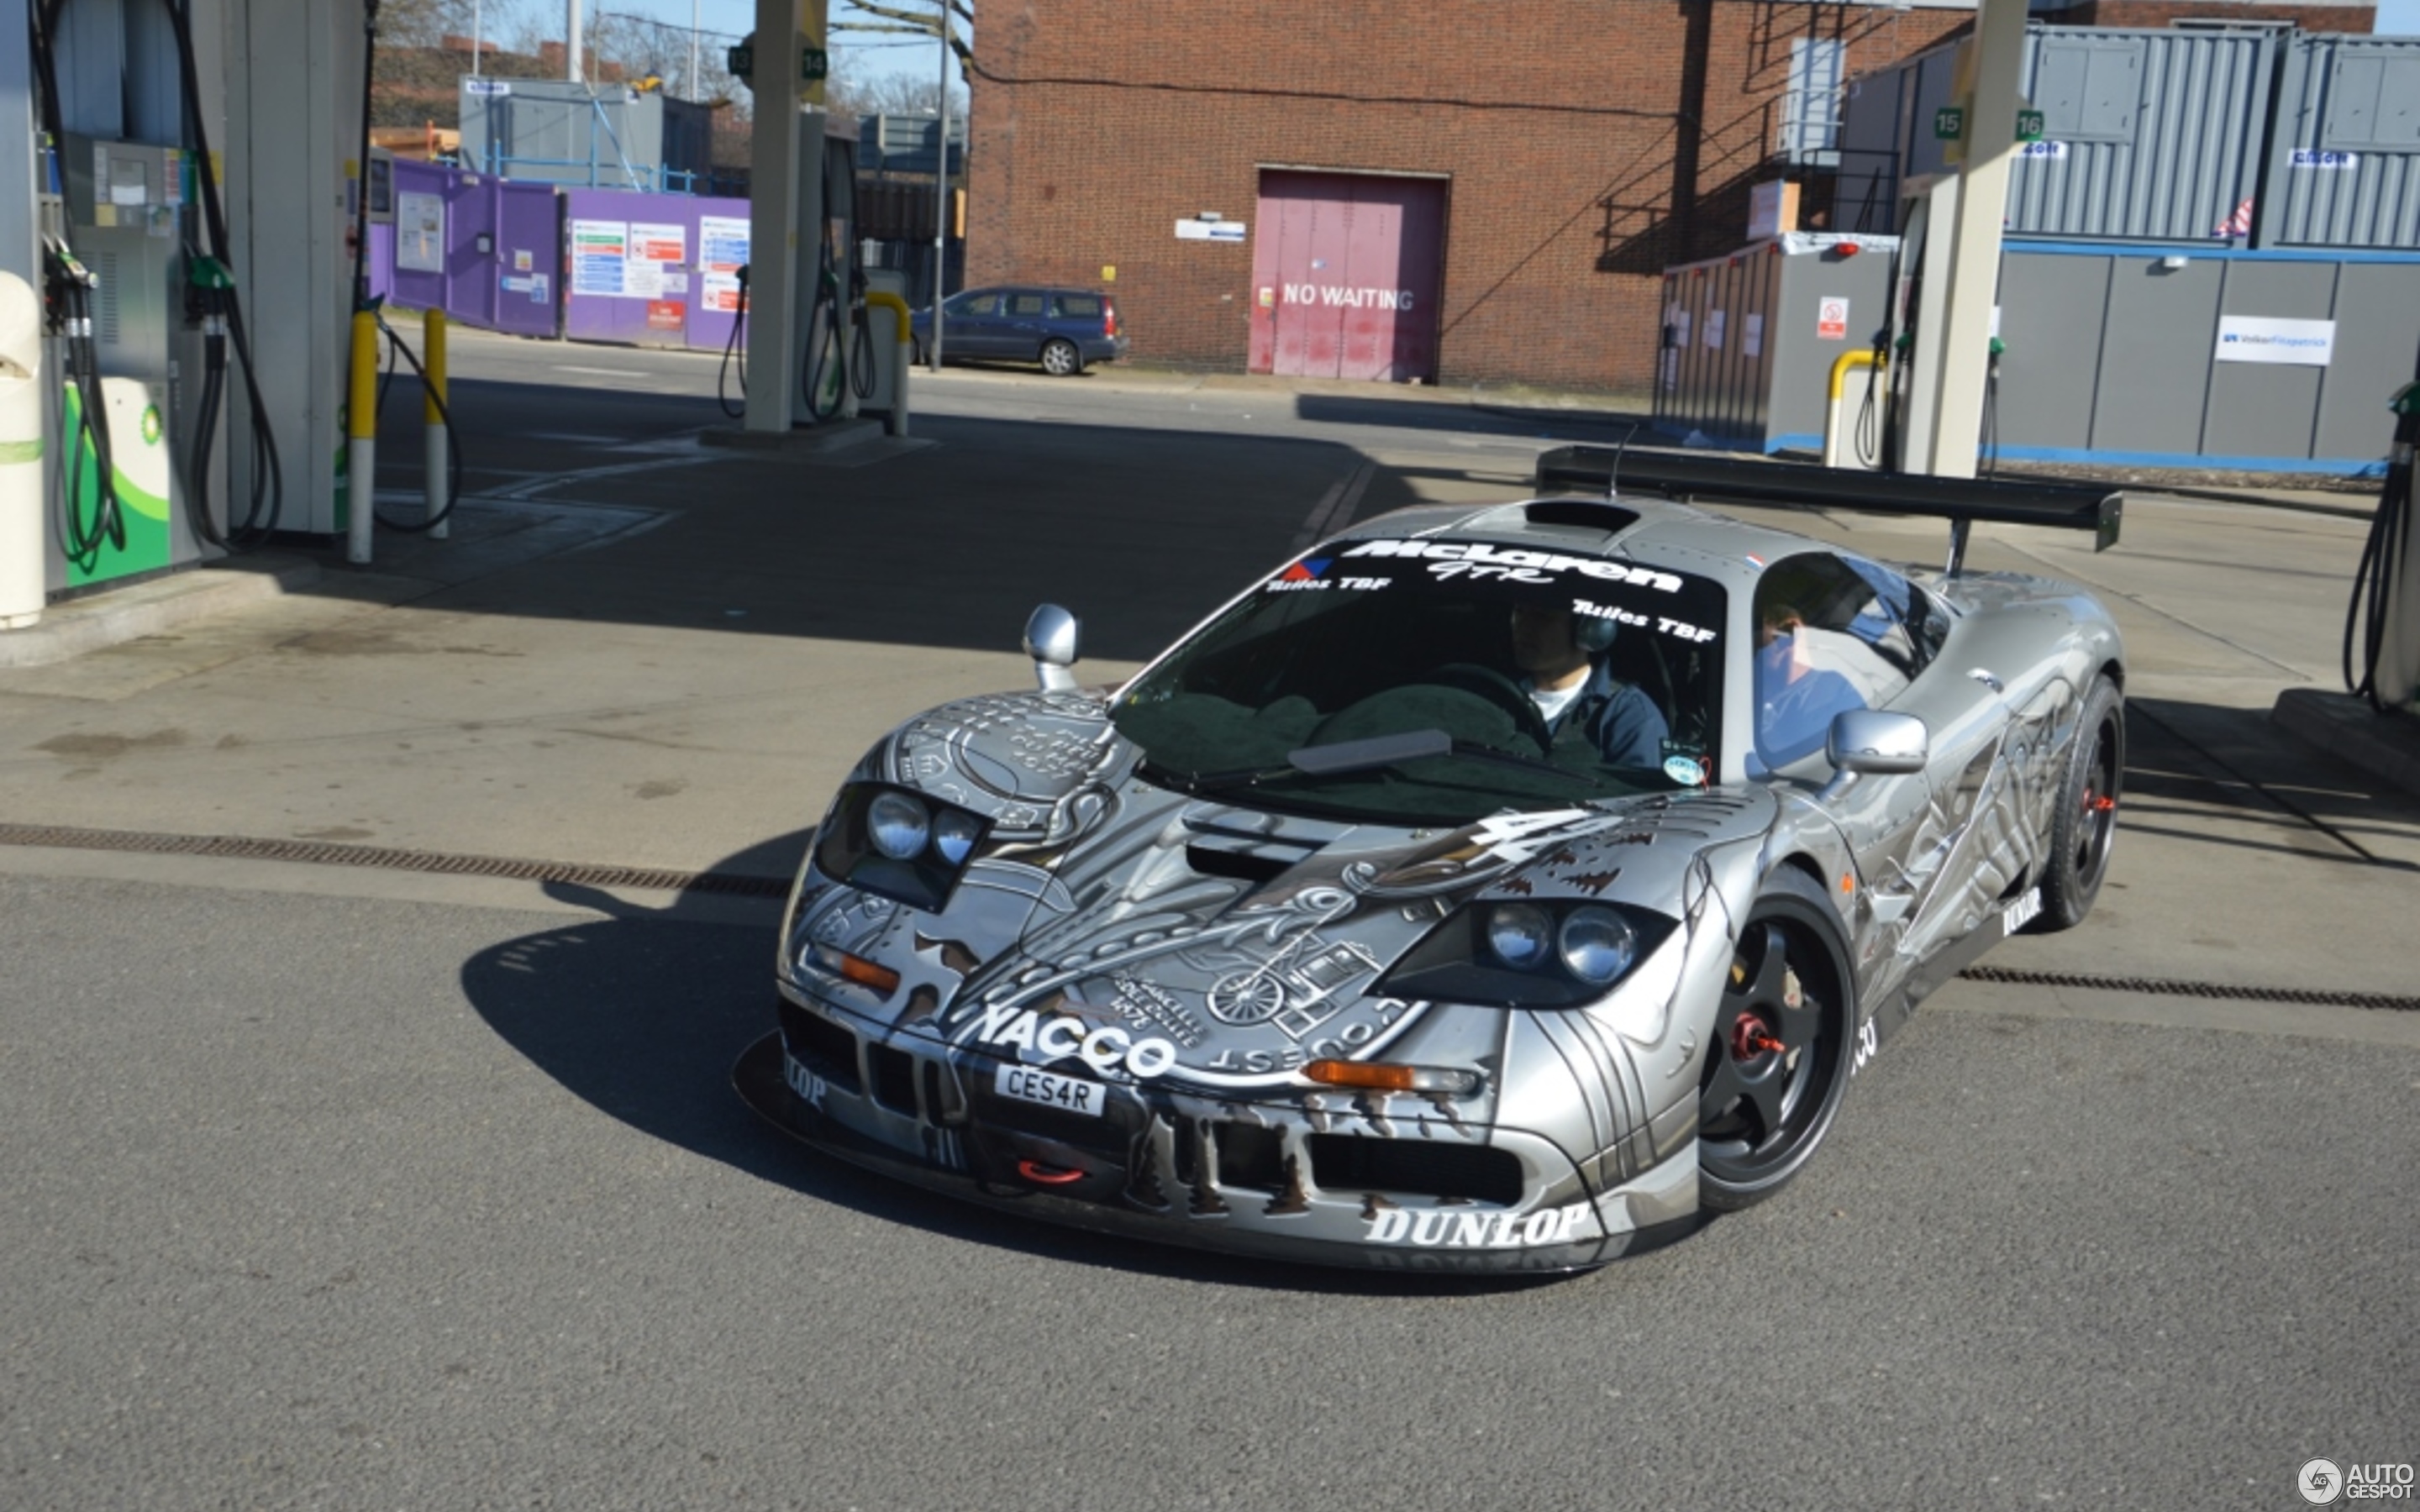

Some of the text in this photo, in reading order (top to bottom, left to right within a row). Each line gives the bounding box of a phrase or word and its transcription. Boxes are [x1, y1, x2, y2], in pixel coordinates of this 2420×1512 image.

[730, 51, 750, 69] 13
[804, 54, 824, 72] 14
[1937, 113, 1960, 133] 15
[2018, 116, 2041, 135] 16
[1283, 283, 1414, 311] NO WAITING
[1339, 539, 1683, 593] McLaren
[1339, 577, 1393, 591] TBF
[1657, 617, 1717, 643] TBF
[977, 1002, 1176, 1079] YACCO
[785, 1054, 826, 1110] LOP
[1007, 1069, 1092, 1110] CES4R
[1364, 1200, 1591, 1247] DUNLOP
